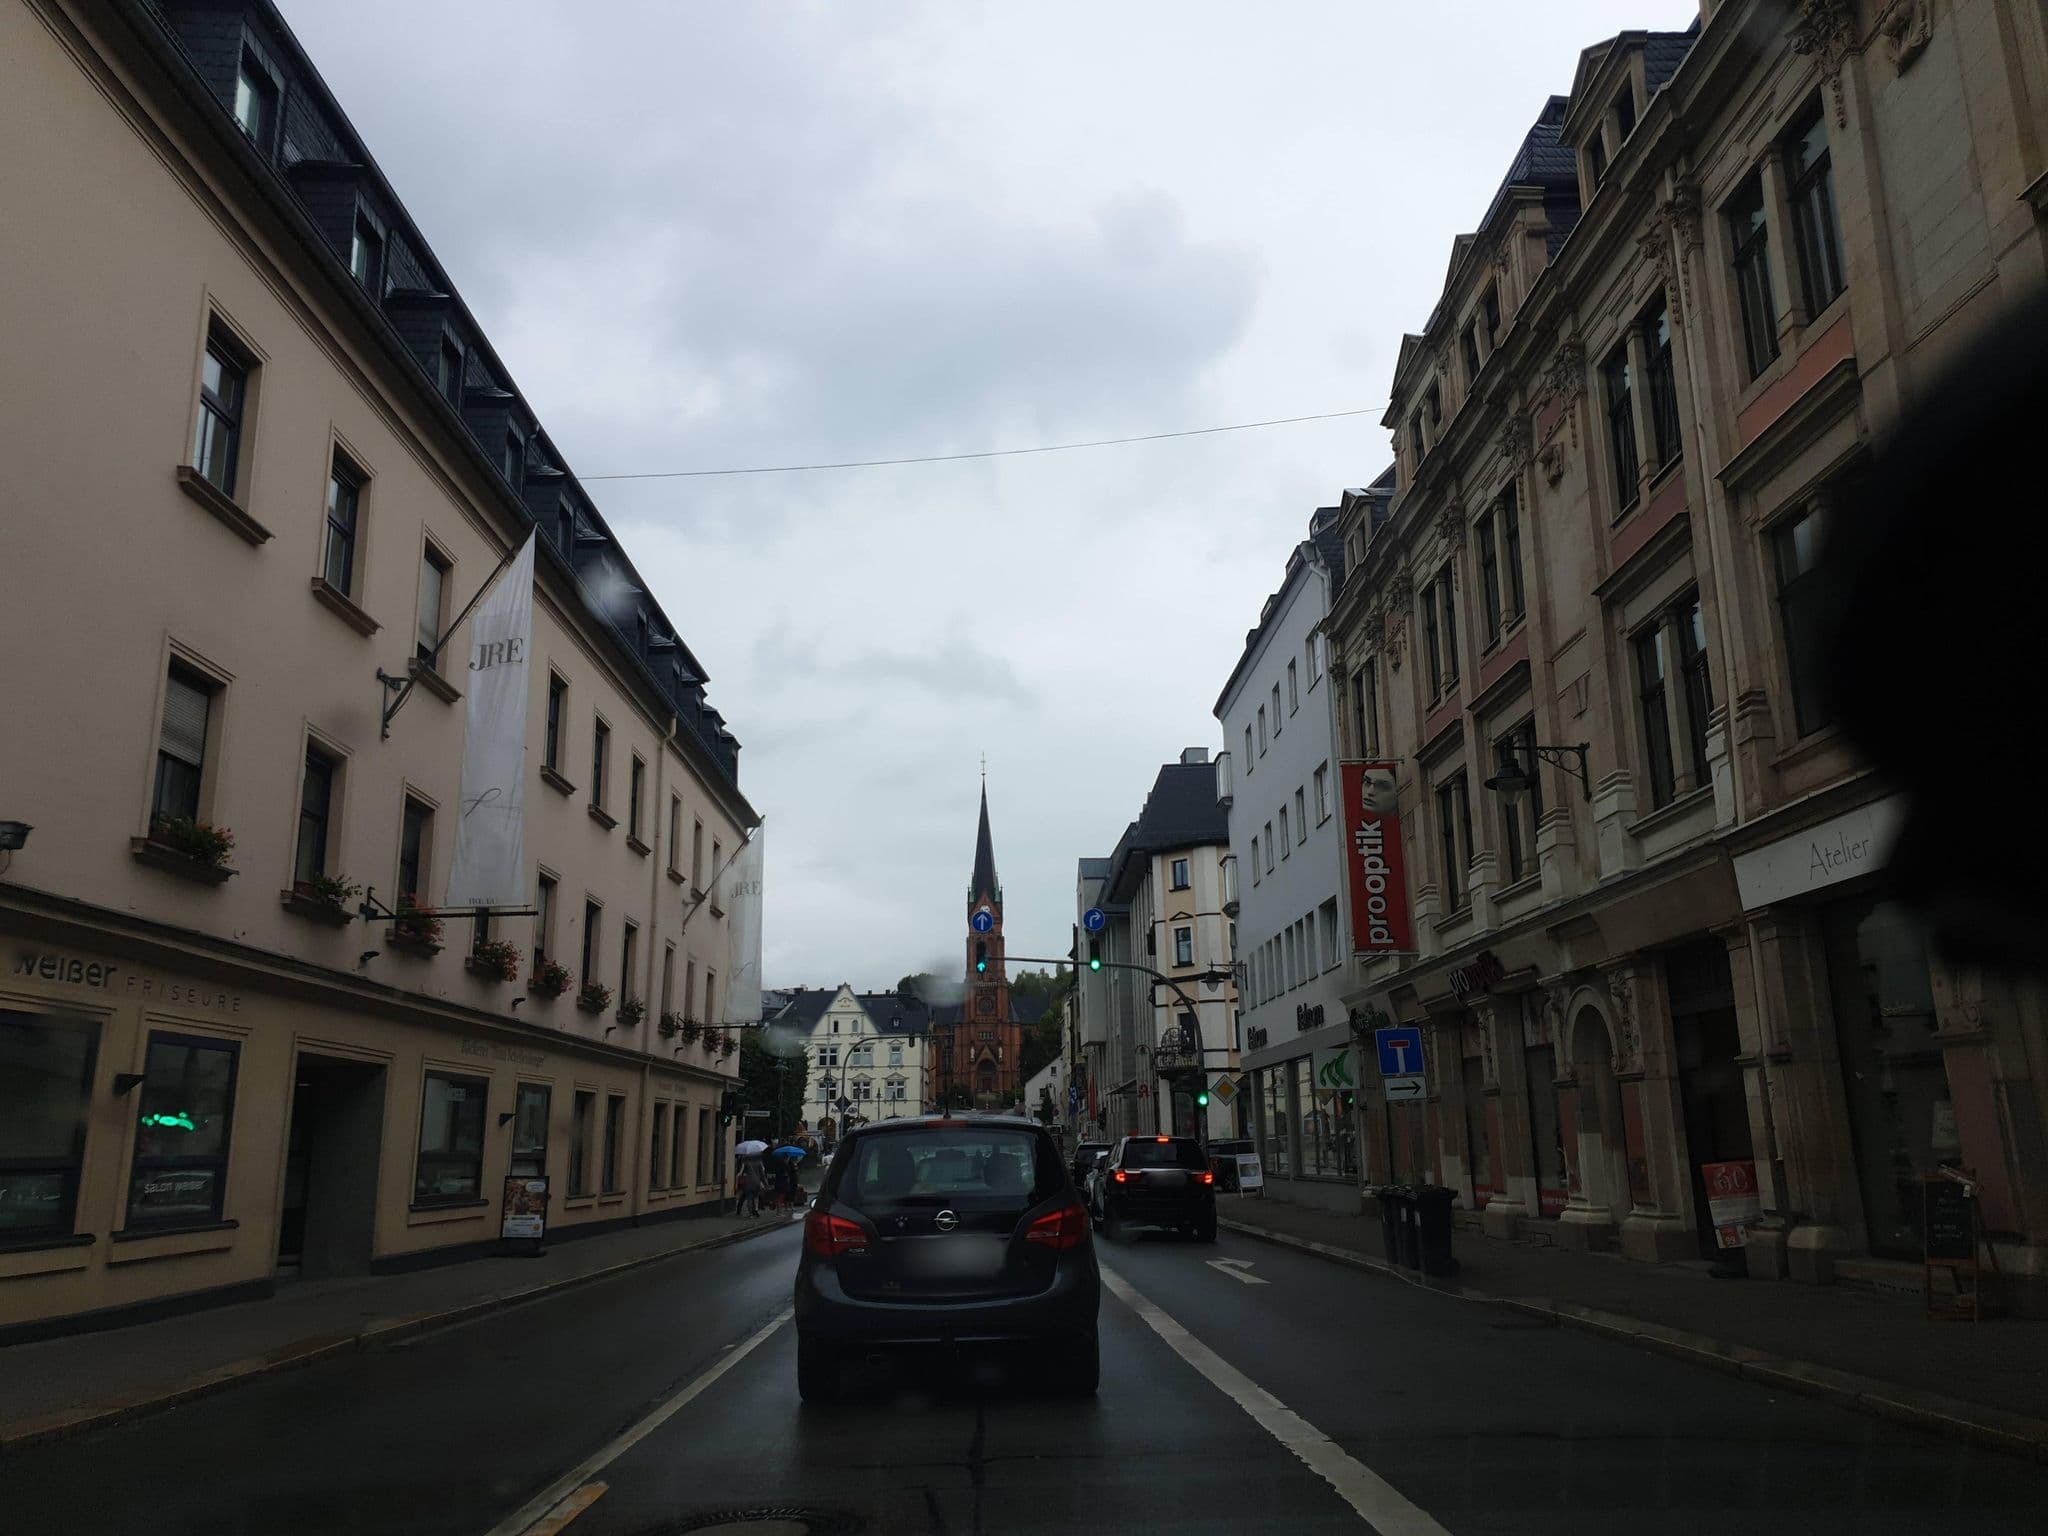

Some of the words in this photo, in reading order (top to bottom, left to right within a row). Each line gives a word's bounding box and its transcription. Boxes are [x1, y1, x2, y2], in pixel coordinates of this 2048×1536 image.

[469, 638, 523, 672] JRE
[1810, 831, 1869, 881] Atelier
[1357, 820, 1394, 945] prooptik
[126, 975, 241, 1012] FRISEURE
